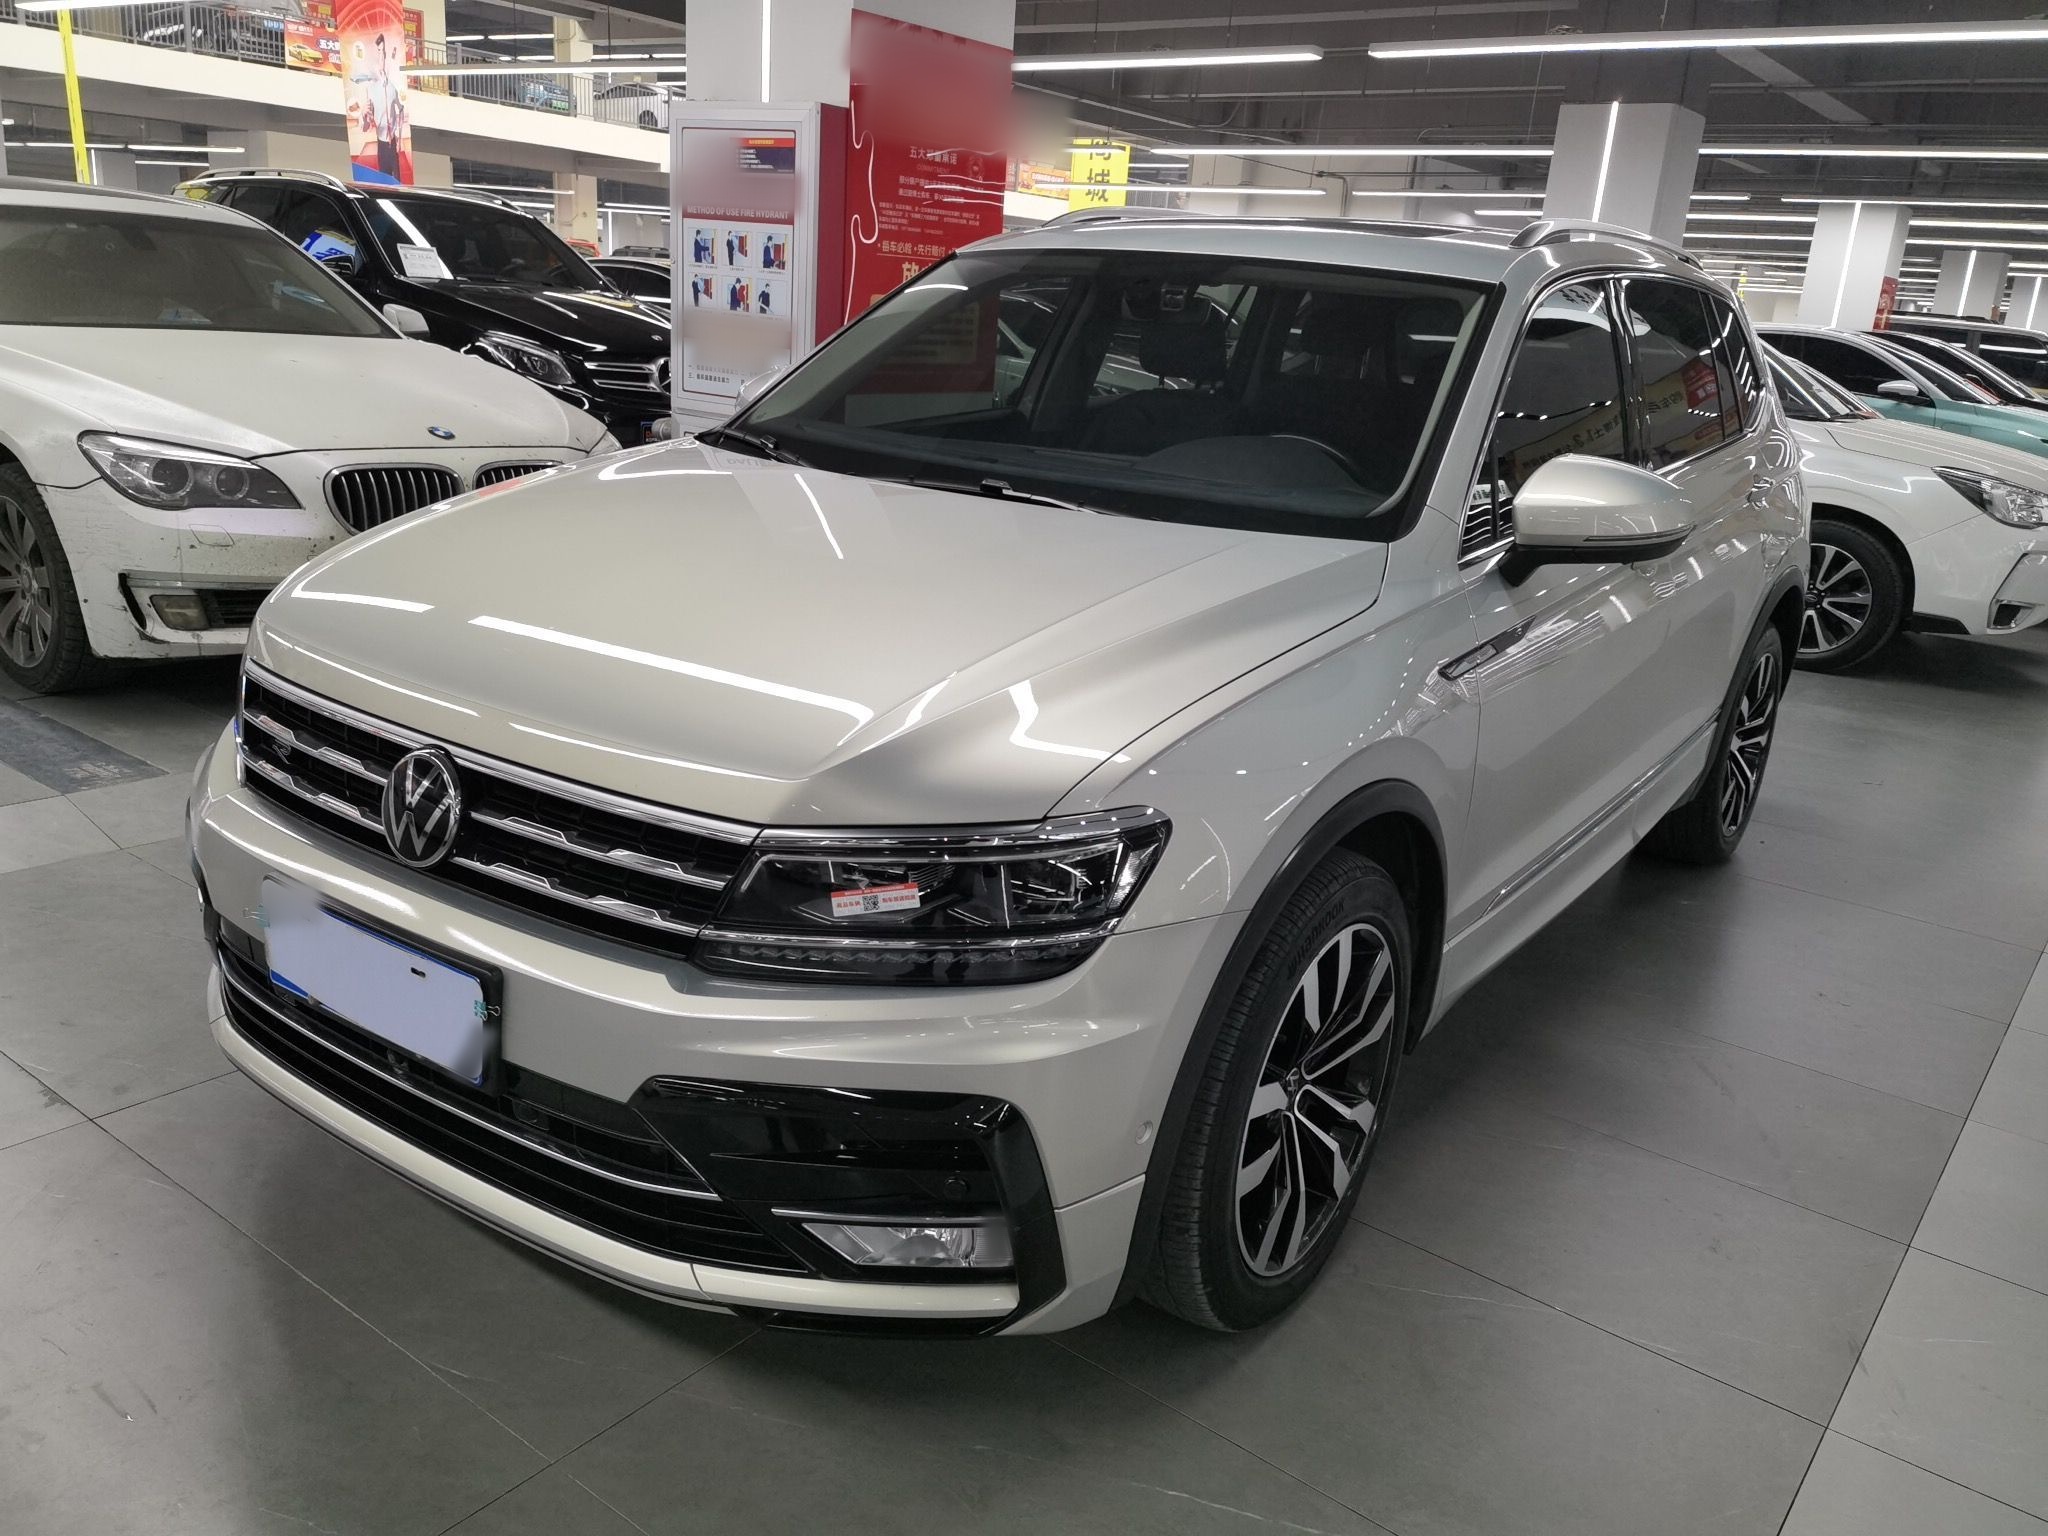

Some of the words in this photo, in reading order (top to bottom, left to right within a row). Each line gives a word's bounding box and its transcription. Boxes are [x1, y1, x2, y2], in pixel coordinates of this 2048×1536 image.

[687, 204, 715, 216] METHOD
[716, 207, 725, 216] OF
[726, 207, 740, 217] USE
[741, 208, 755, 218] FIRE
[756, 209, 789, 220] HYDRANT
